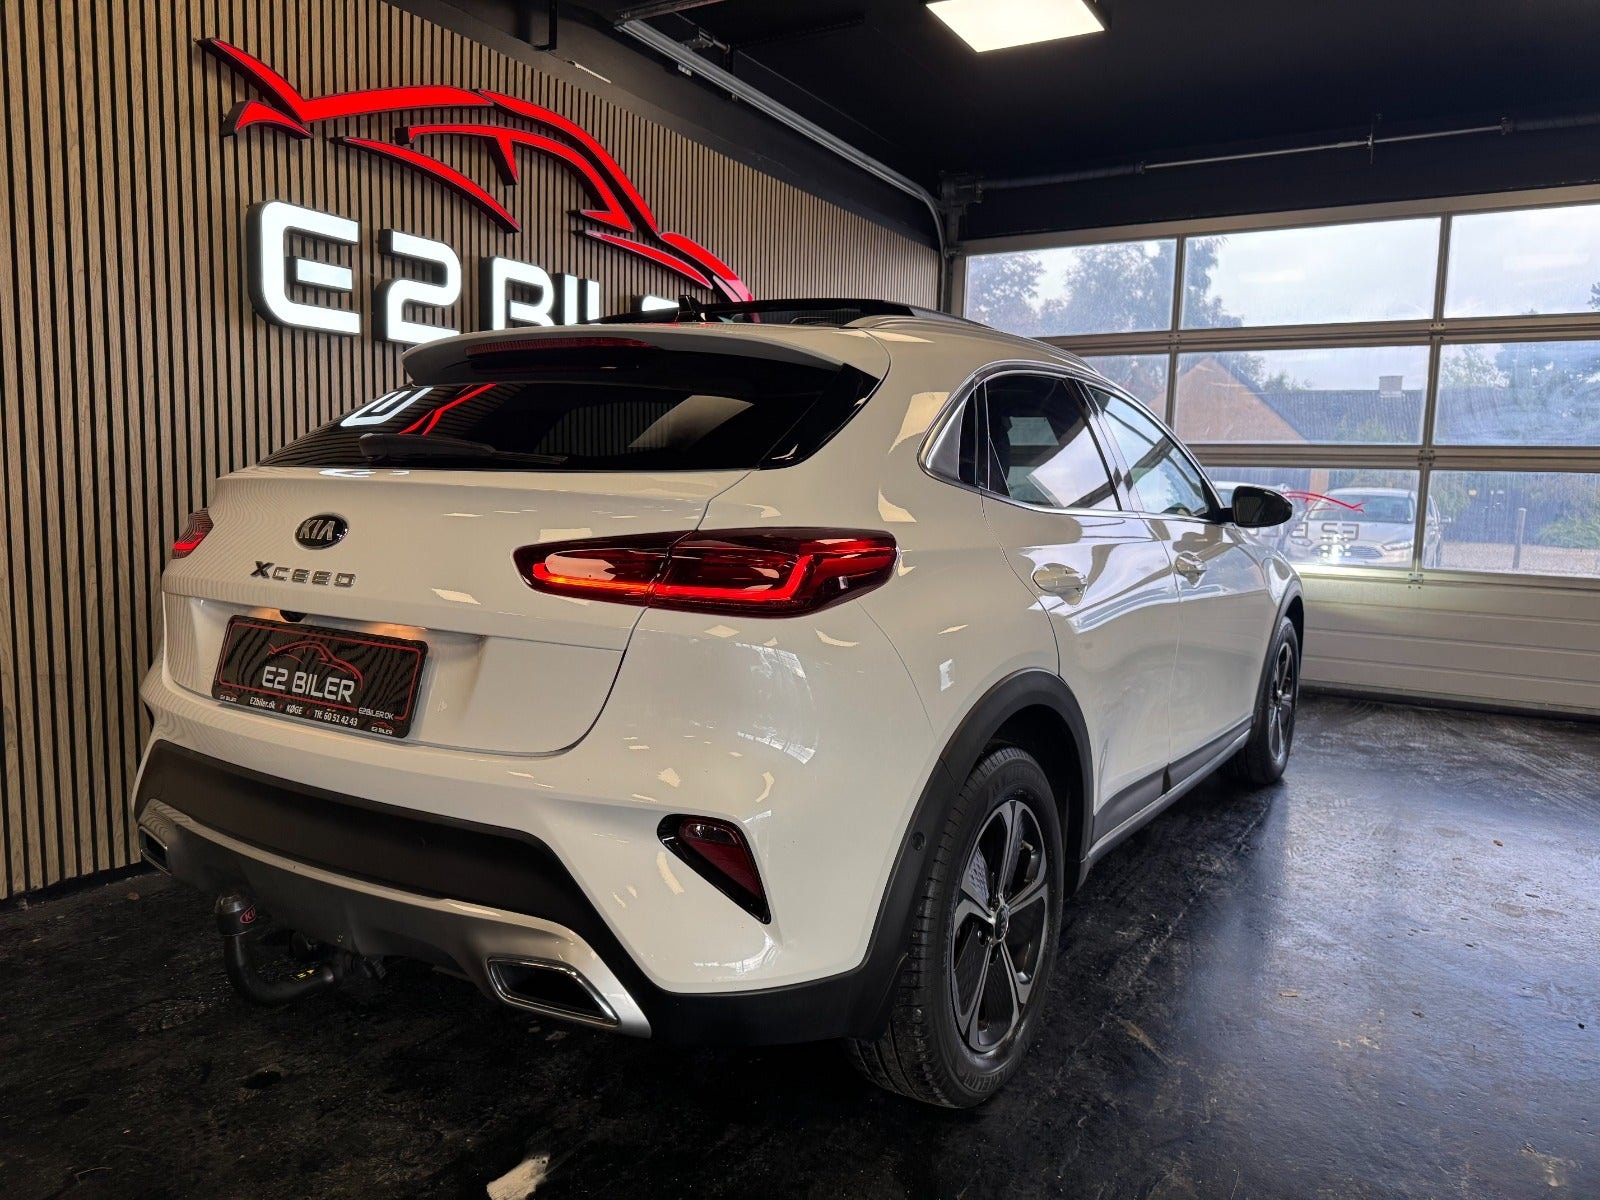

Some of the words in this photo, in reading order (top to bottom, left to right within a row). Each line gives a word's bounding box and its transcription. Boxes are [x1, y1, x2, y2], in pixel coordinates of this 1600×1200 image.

[260, 200, 462, 343] E2
[298, 519, 336, 541] KIA
[250, 560, 357, 588] XCEED
[262, 665, 288, 690] E2
[292, 671, 355, 704] BILER
[249, 696, 276, 710] E2biler.dk
[285, 703, 304, 715] KØGE
[323, 711, 332, 721] 60
[332, 713, 340, 723] 51
[340, 715, 349, 725] 42
[349, 717, 358, 727] 43
